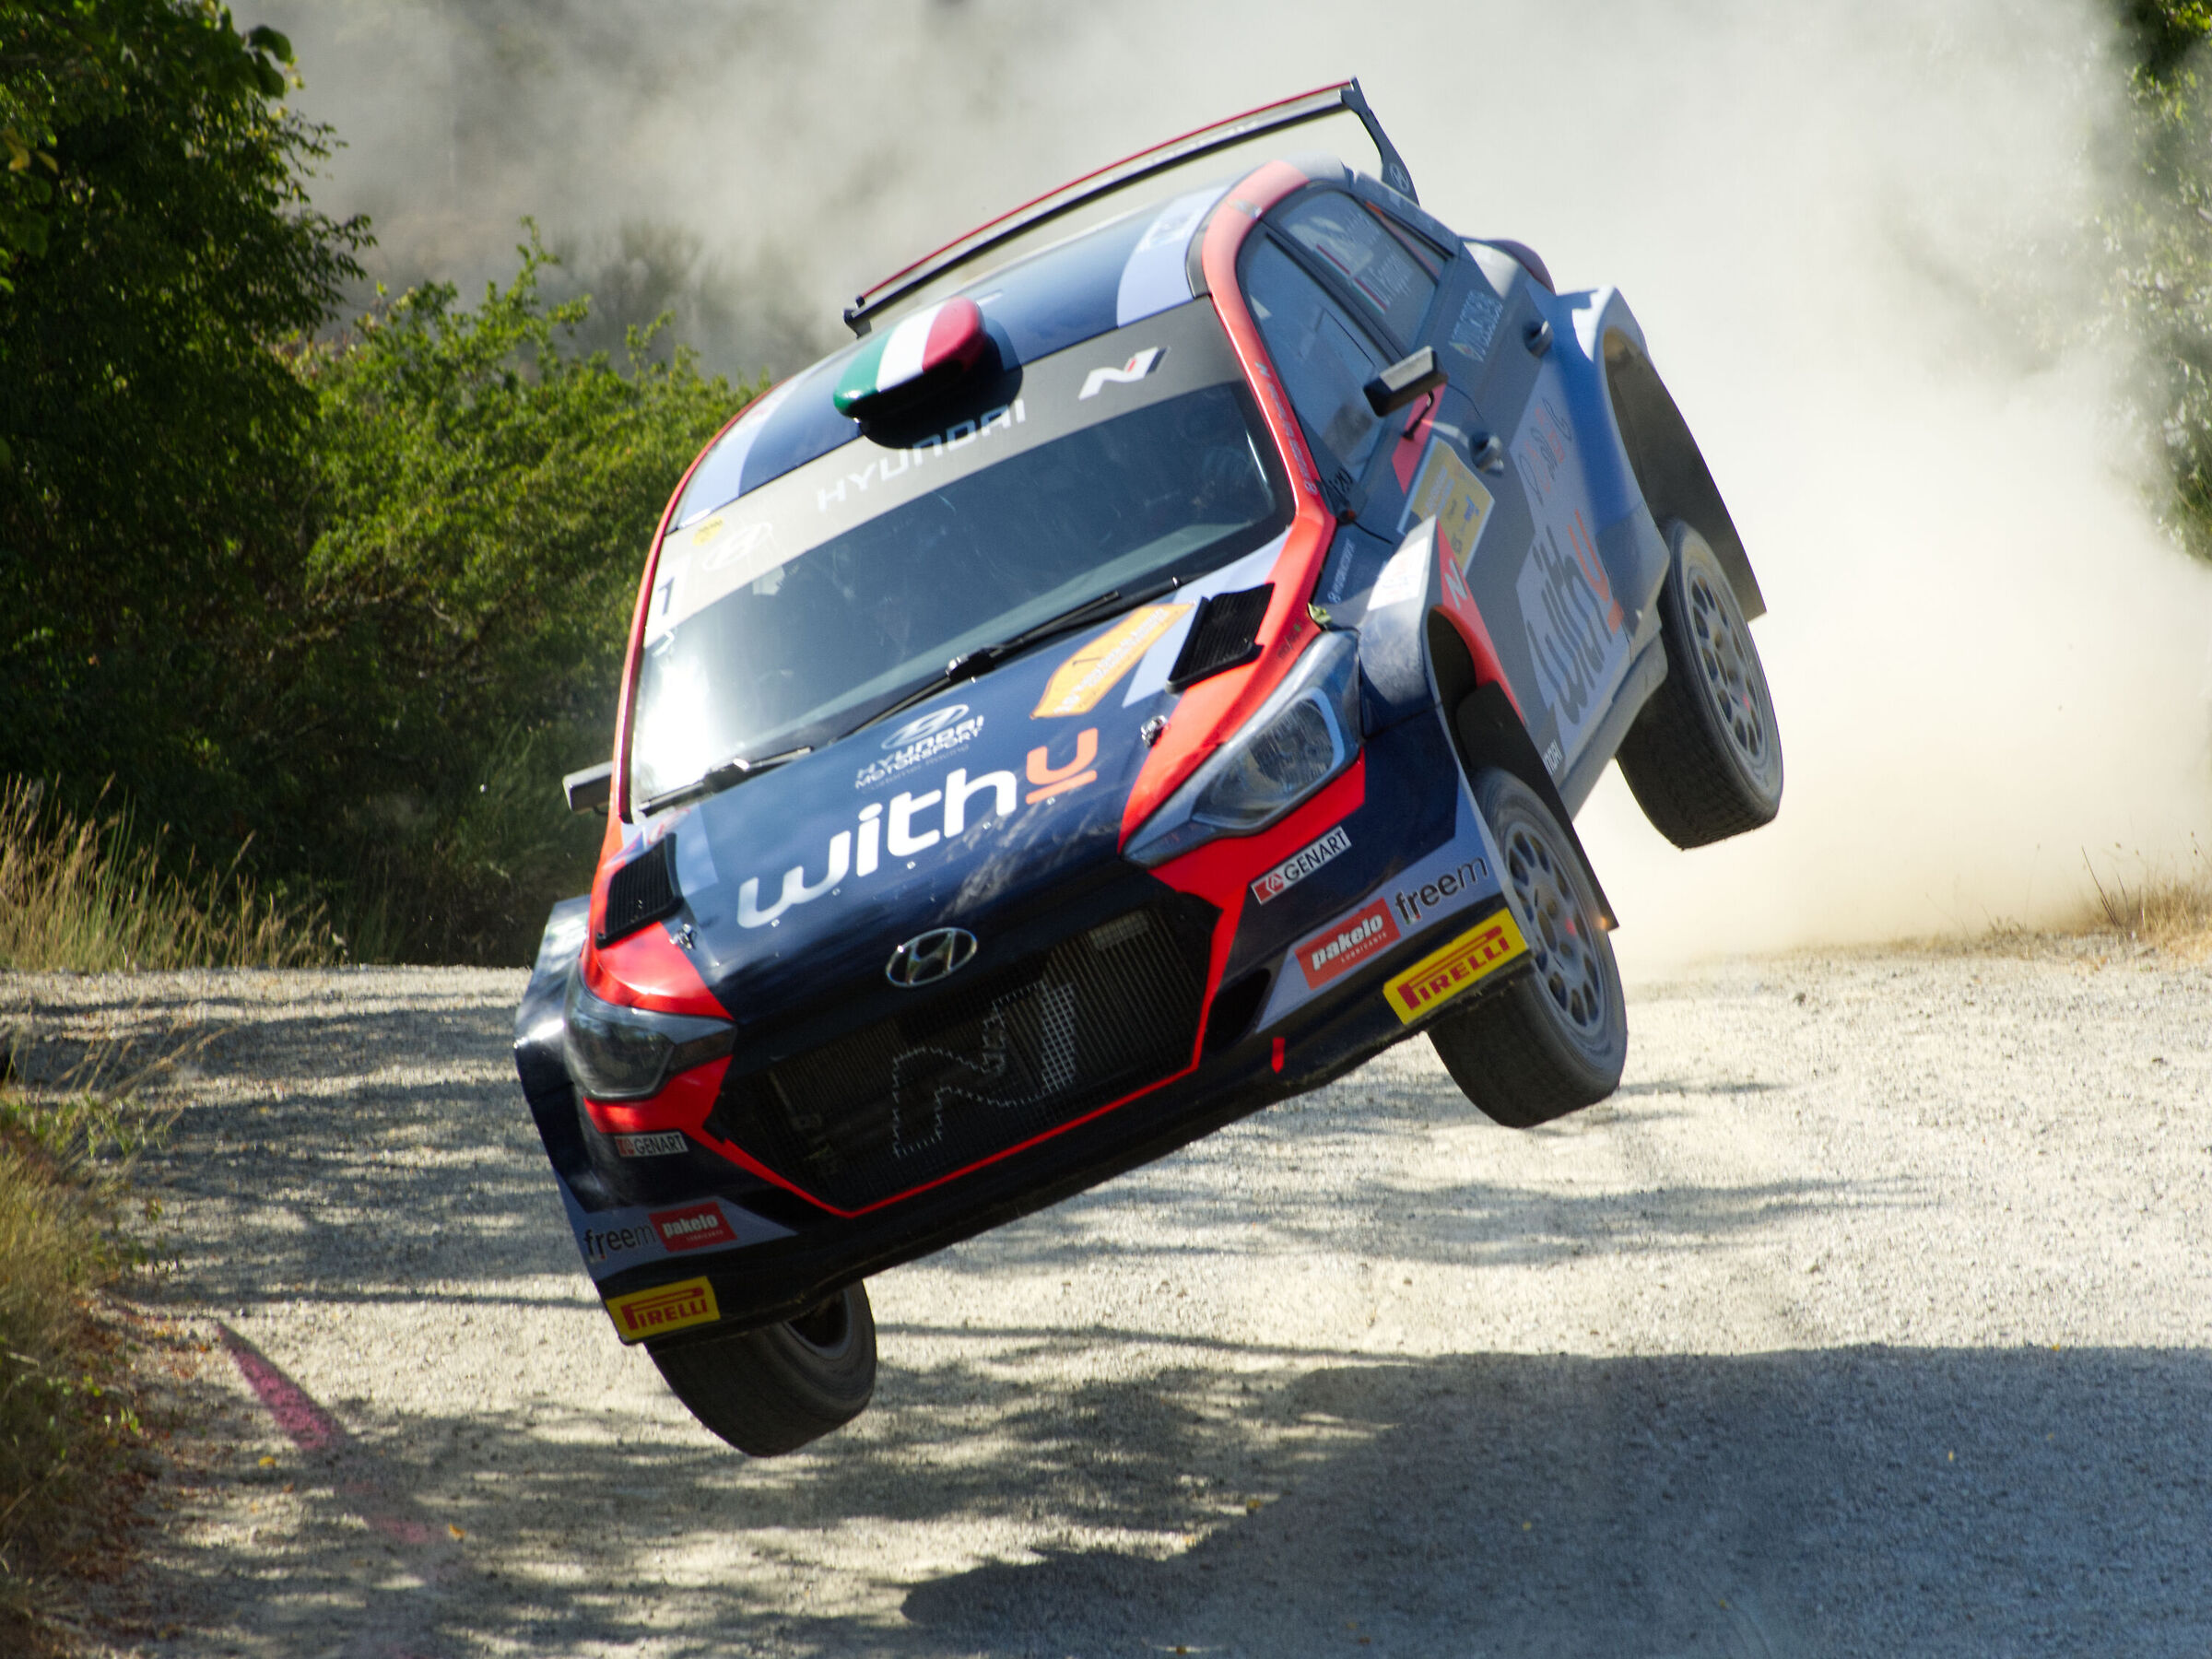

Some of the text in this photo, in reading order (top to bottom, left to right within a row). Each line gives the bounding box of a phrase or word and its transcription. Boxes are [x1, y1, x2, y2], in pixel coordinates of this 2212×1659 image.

[816, 397, 1028, 513] HYUNDAI
[854, 725, 982, 790] MOTORSPORT
[856, 714, 985, 780] HYUNDAI
[1284, 831, 1347, 882] GENART
[1395, 857, 1488, 925] freem
[1312, 914, 1383, 971] pakelo
[1396, 925, 1512, 1011] PIRELLI
[634, 1135, 684, 1155] GENART
[583, 1223, 656, 1264] freem
[661, 1214, 719, 1240] pakelo
[620, 1287, 709, 1331] PIRELLI
